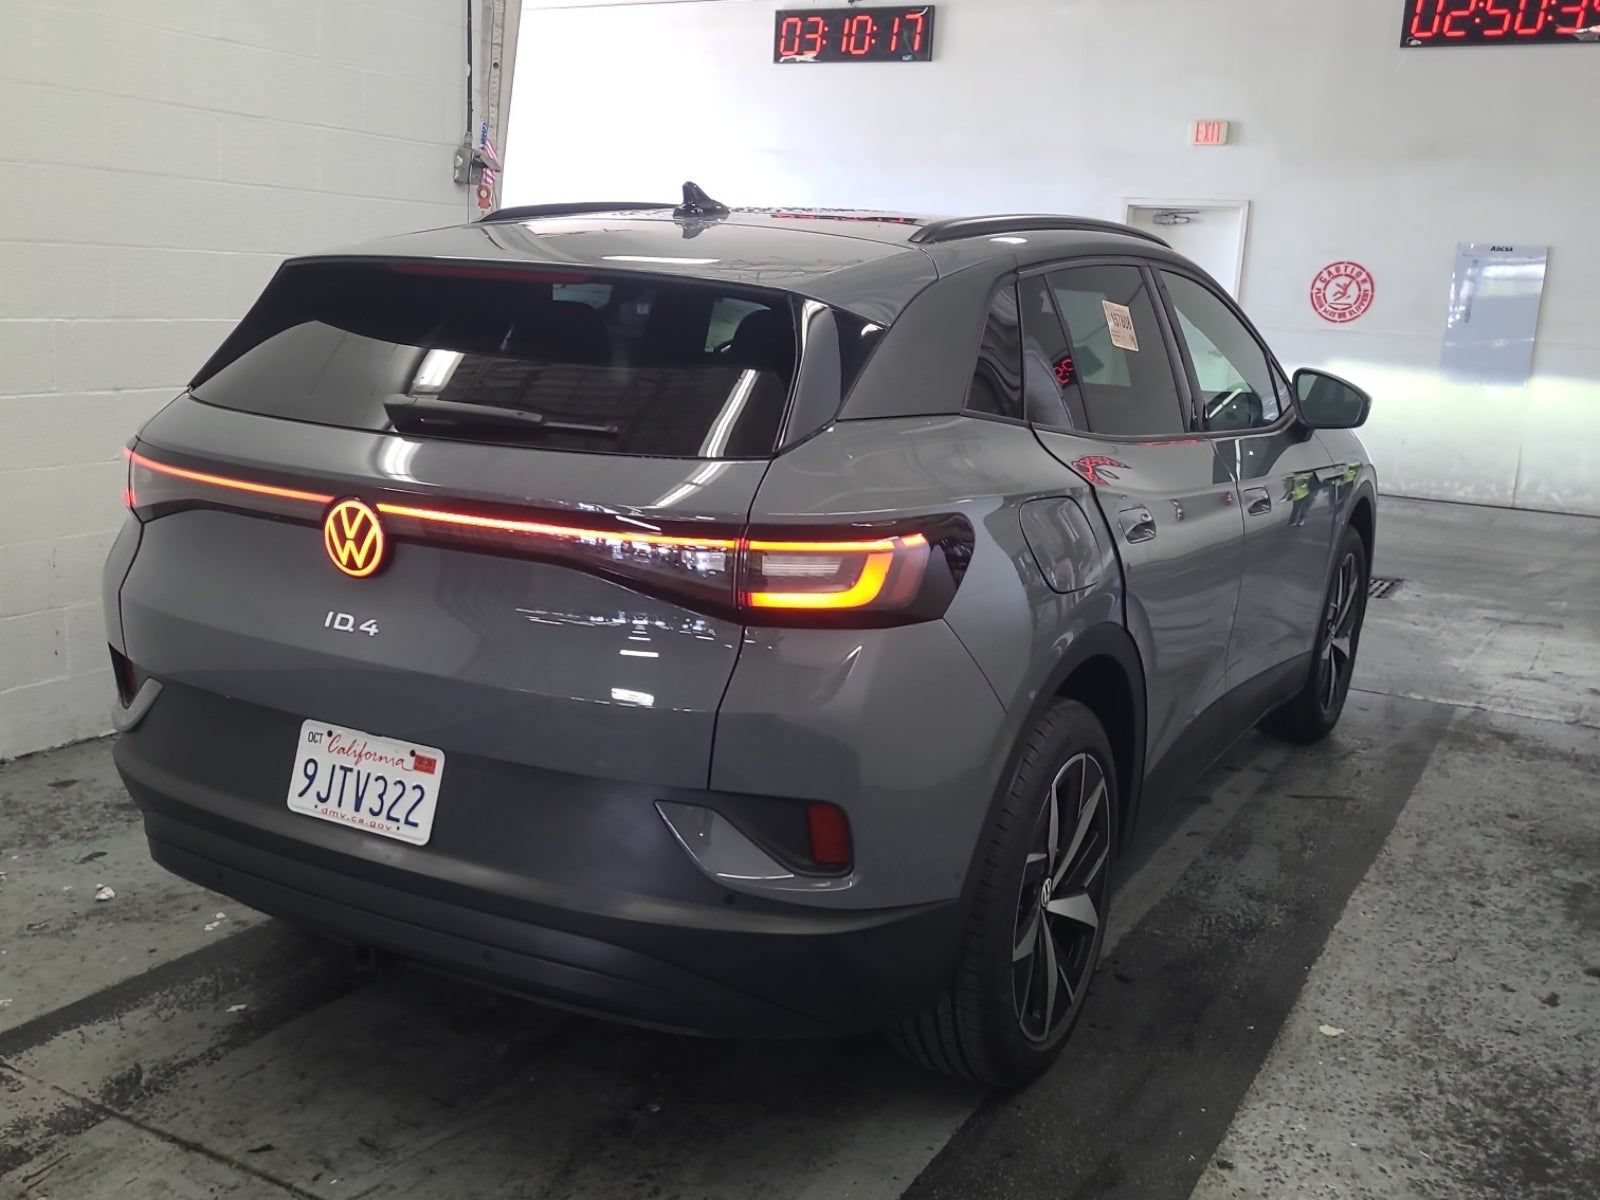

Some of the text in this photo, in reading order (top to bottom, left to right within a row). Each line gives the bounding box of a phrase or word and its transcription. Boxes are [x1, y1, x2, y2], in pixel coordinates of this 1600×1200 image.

[779, 15, 923, 56] 03:10:17
[1195, 120, 1225, 143] EXIT
[1319, 265, 1369, 285] CAUTION
[307, 731, 325, 745] OCT
[327, 734, 415, 772] California
[297, 758, 426, 828] 9JTV322
[321, 807, 393, 831] dmv.ca.gov
